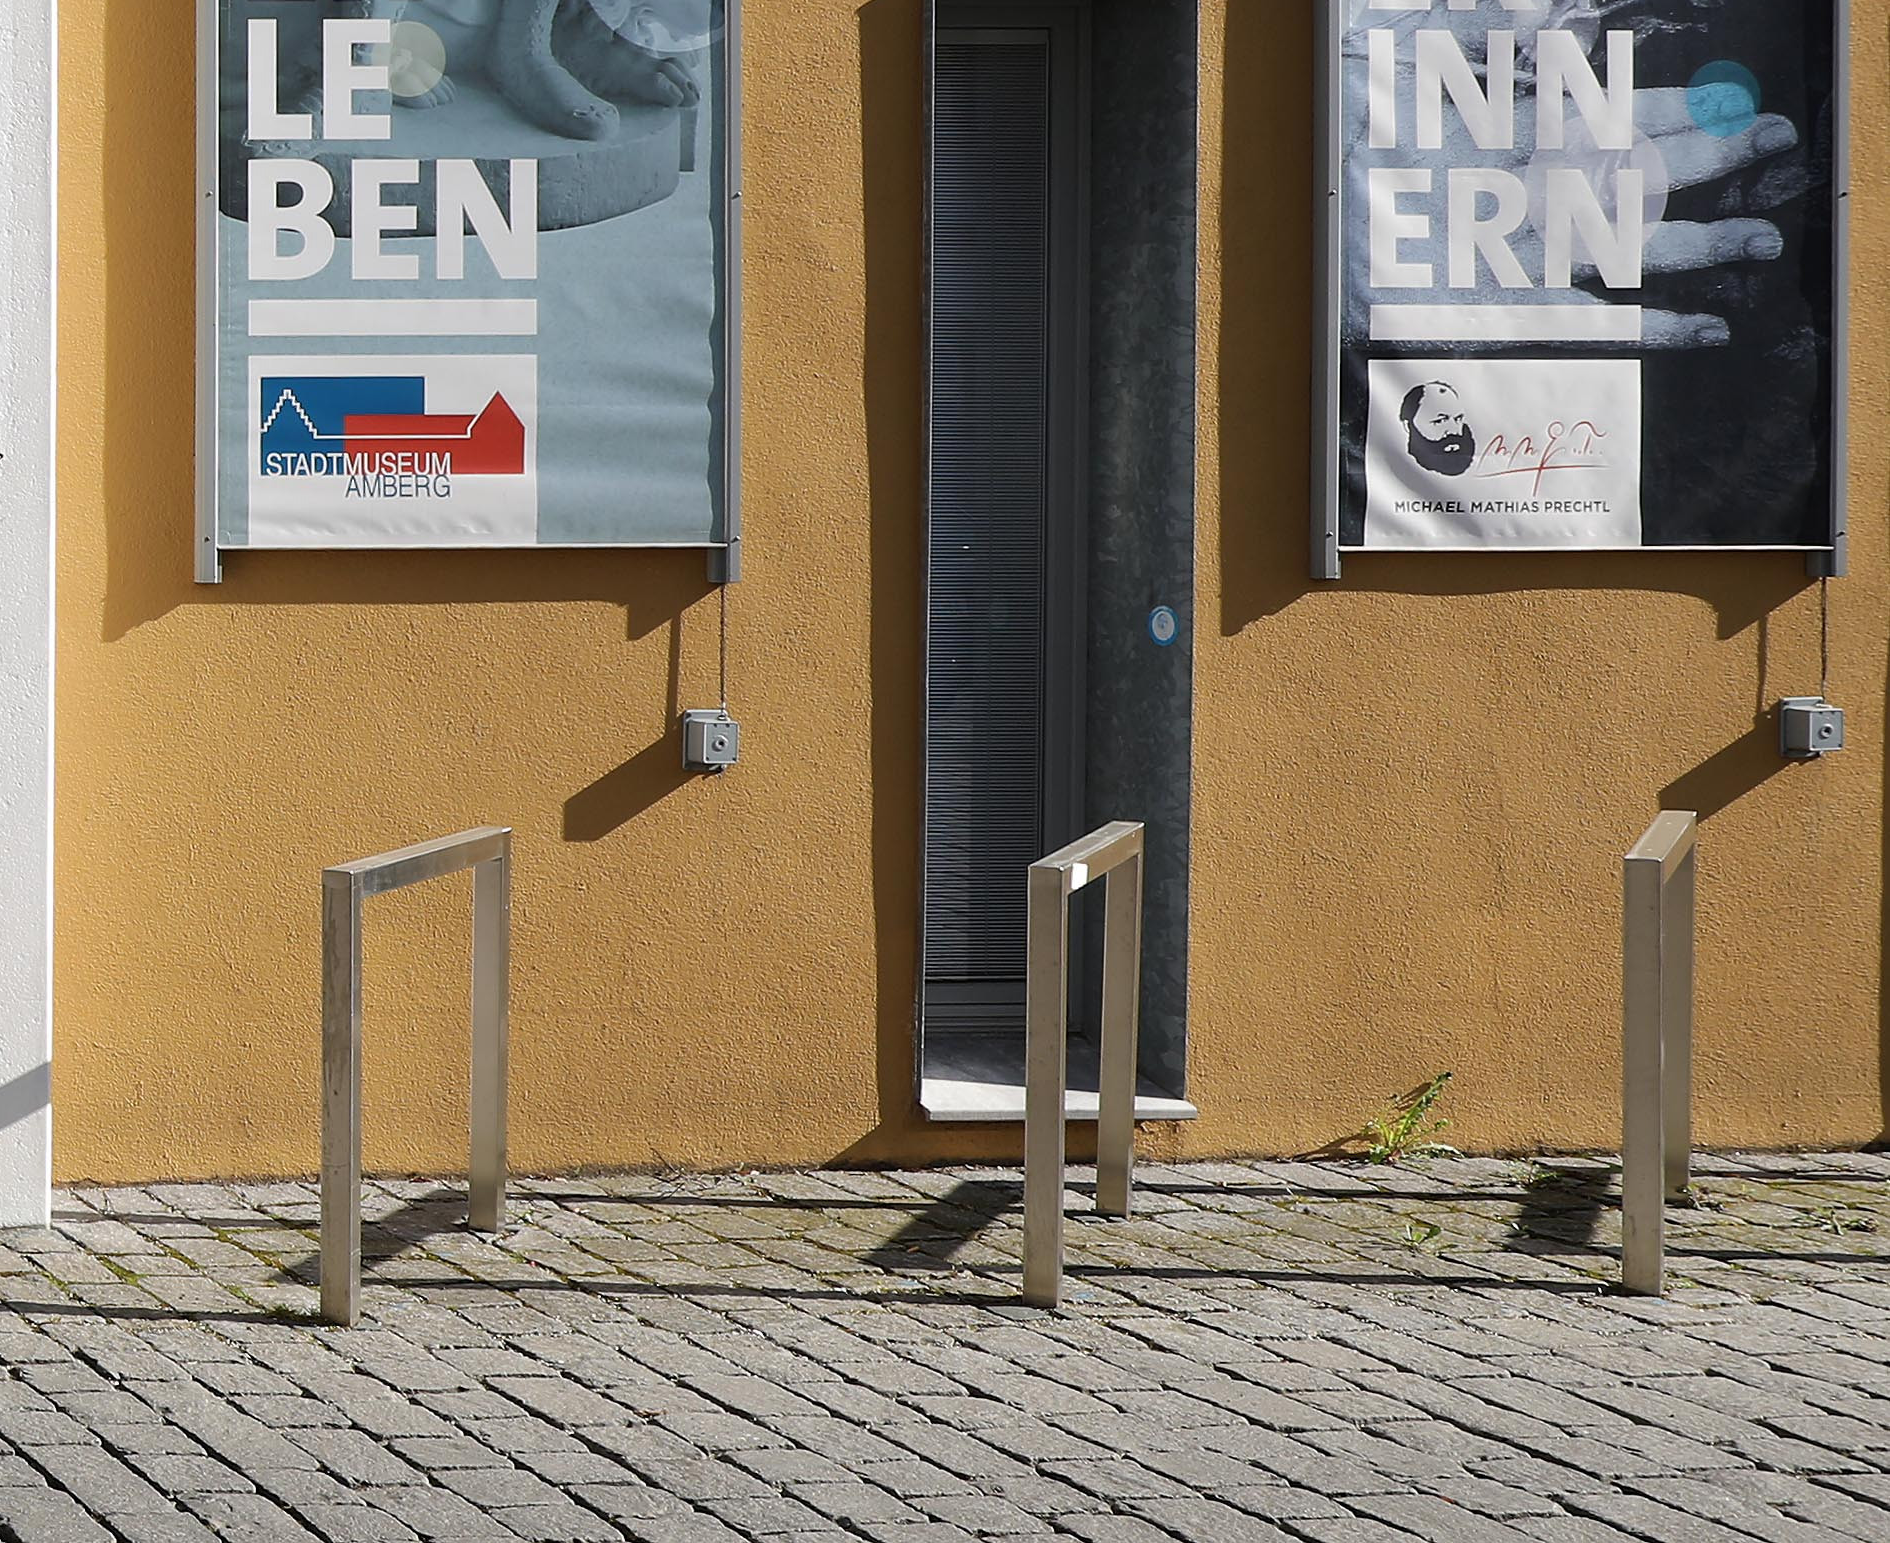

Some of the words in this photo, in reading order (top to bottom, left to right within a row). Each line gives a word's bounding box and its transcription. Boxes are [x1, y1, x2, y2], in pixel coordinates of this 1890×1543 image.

[247, 18, 392, 141] LE
[1368, 29, 1635, 150] INN
[247, 157, 538, 281] BEN
[1368, 168, 1643, 290] ERN
[265, 451, 452, 475] STADTMUSEUM
[344, 474, 452, 499] AMBERG
[1393, 500, 1466, 514] MICHAEL
[1470, 500, 1540, 514] MATHIAS
[1544, 500, 1611, 514] PRECHTL
